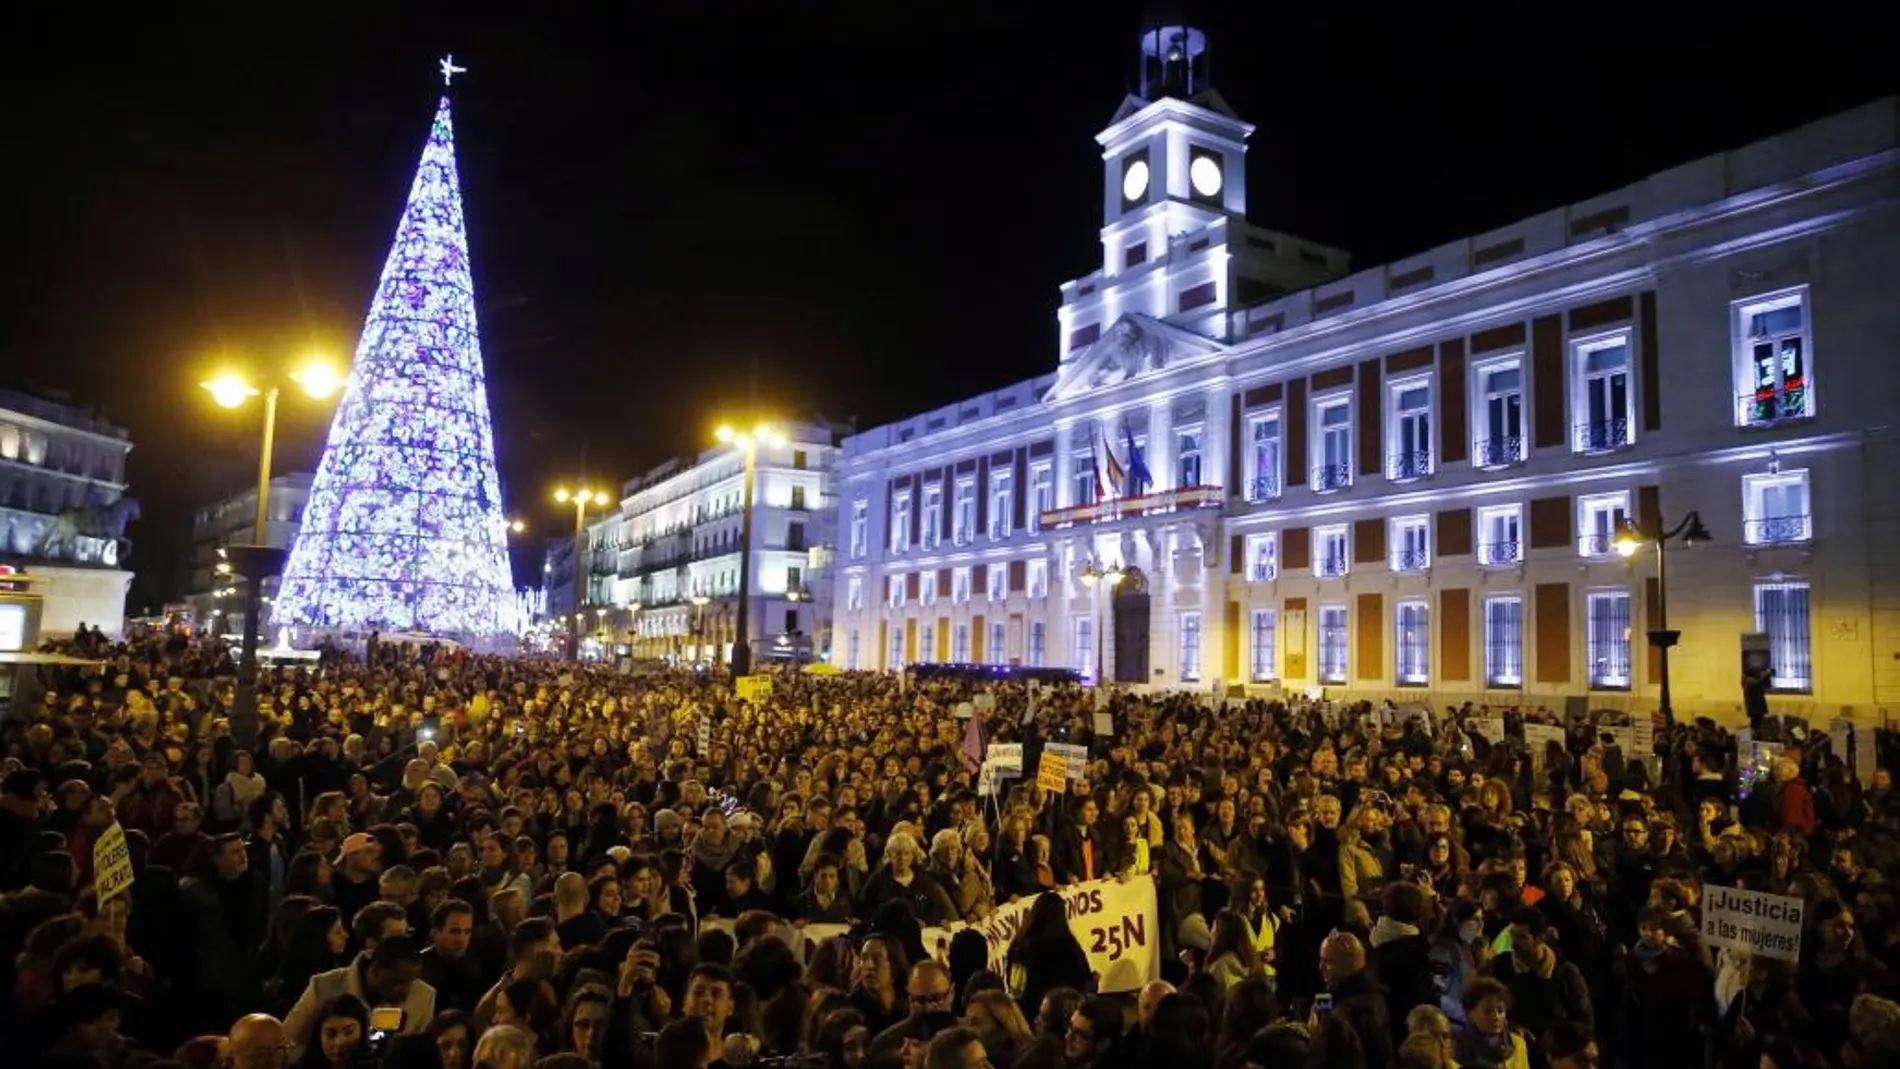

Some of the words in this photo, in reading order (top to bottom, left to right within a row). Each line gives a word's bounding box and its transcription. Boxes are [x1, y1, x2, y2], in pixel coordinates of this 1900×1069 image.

[1708, 891, 1800, 923] ¡Justicia
[1091, 914, 1145, 960] 25N
[1708, 921, 1715, 935] a
[1719, 919, 1737, 939] las
[1741, 927, 1799, 952] mujeres!
